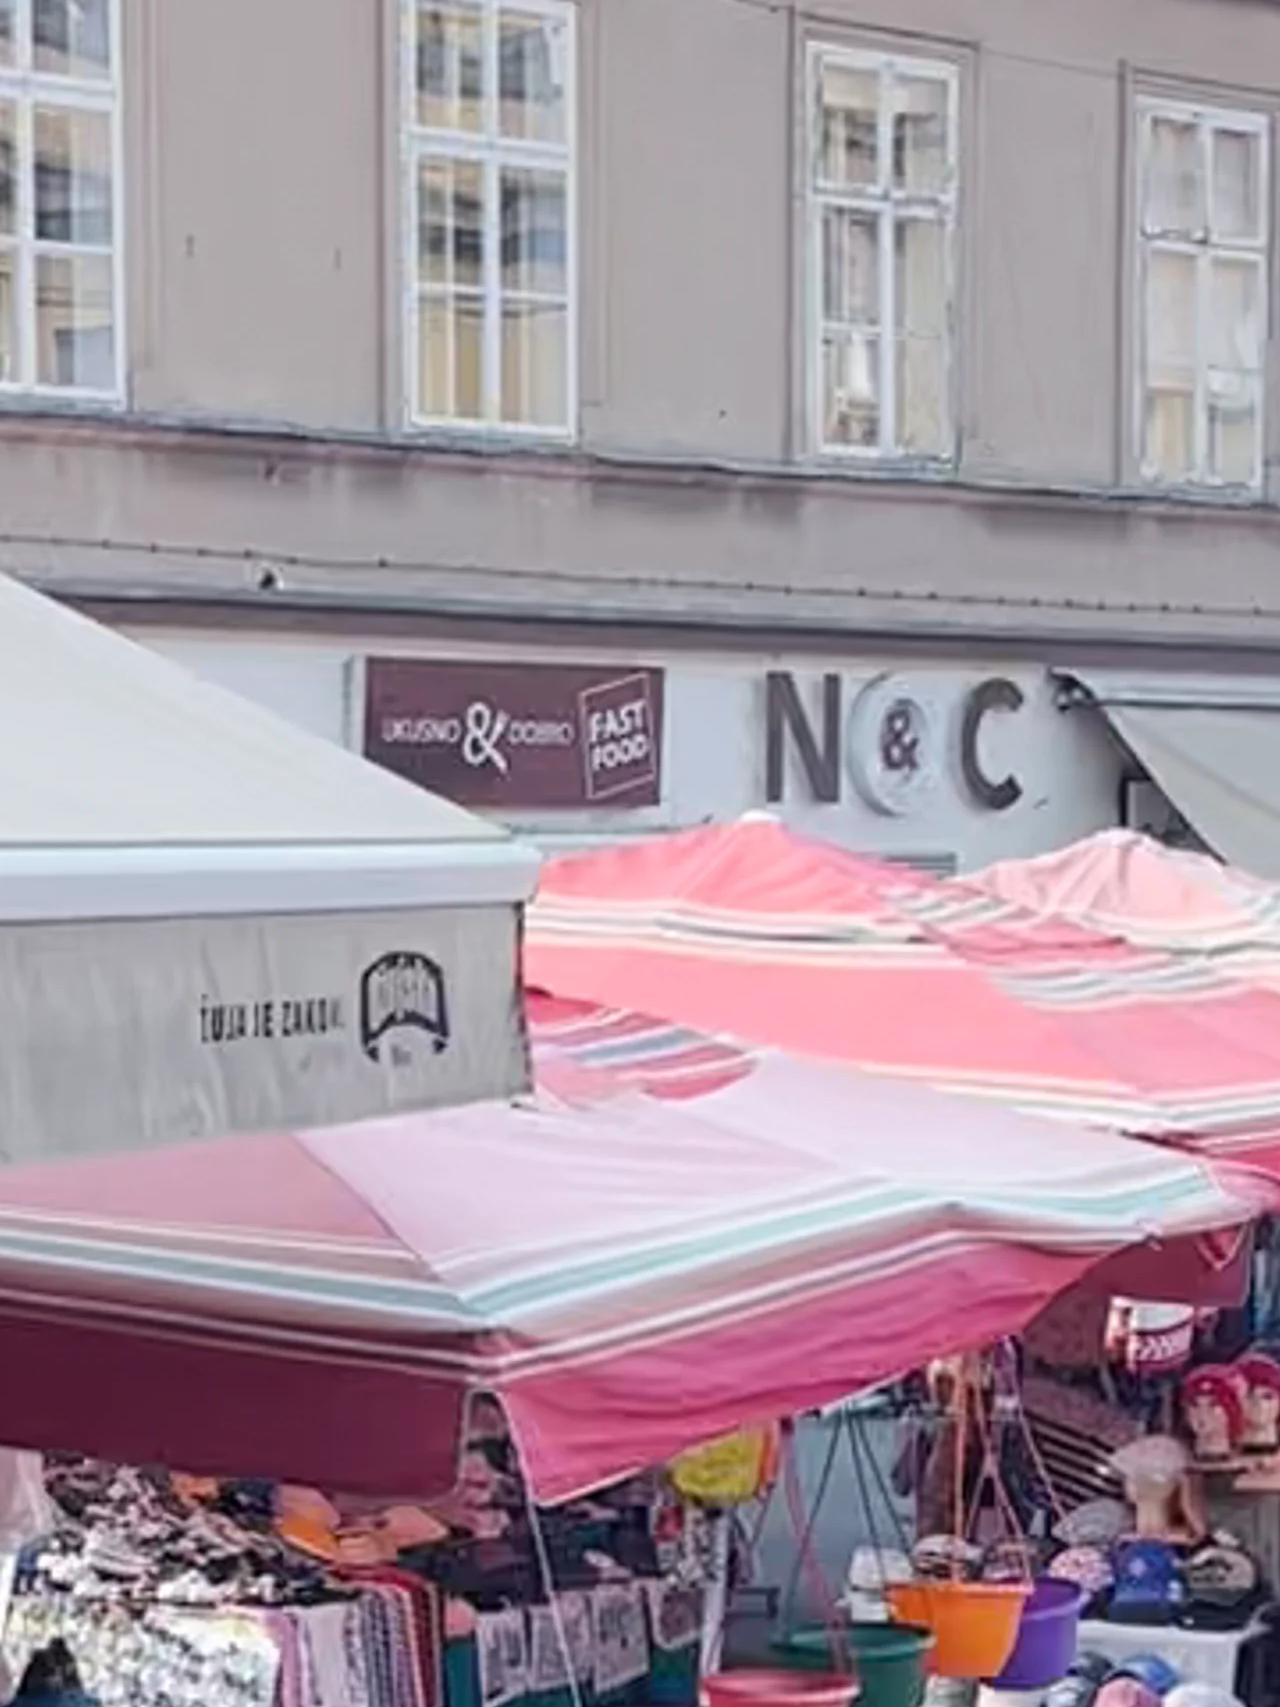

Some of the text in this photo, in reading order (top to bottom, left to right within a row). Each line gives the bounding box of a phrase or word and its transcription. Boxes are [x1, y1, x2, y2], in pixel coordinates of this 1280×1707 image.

[463, 700, 510, 776] &
[588, 698, 647, 743] FAST
[766, 672, 1024, 810] N & C
[591, 734, 650, 772] FOOD
